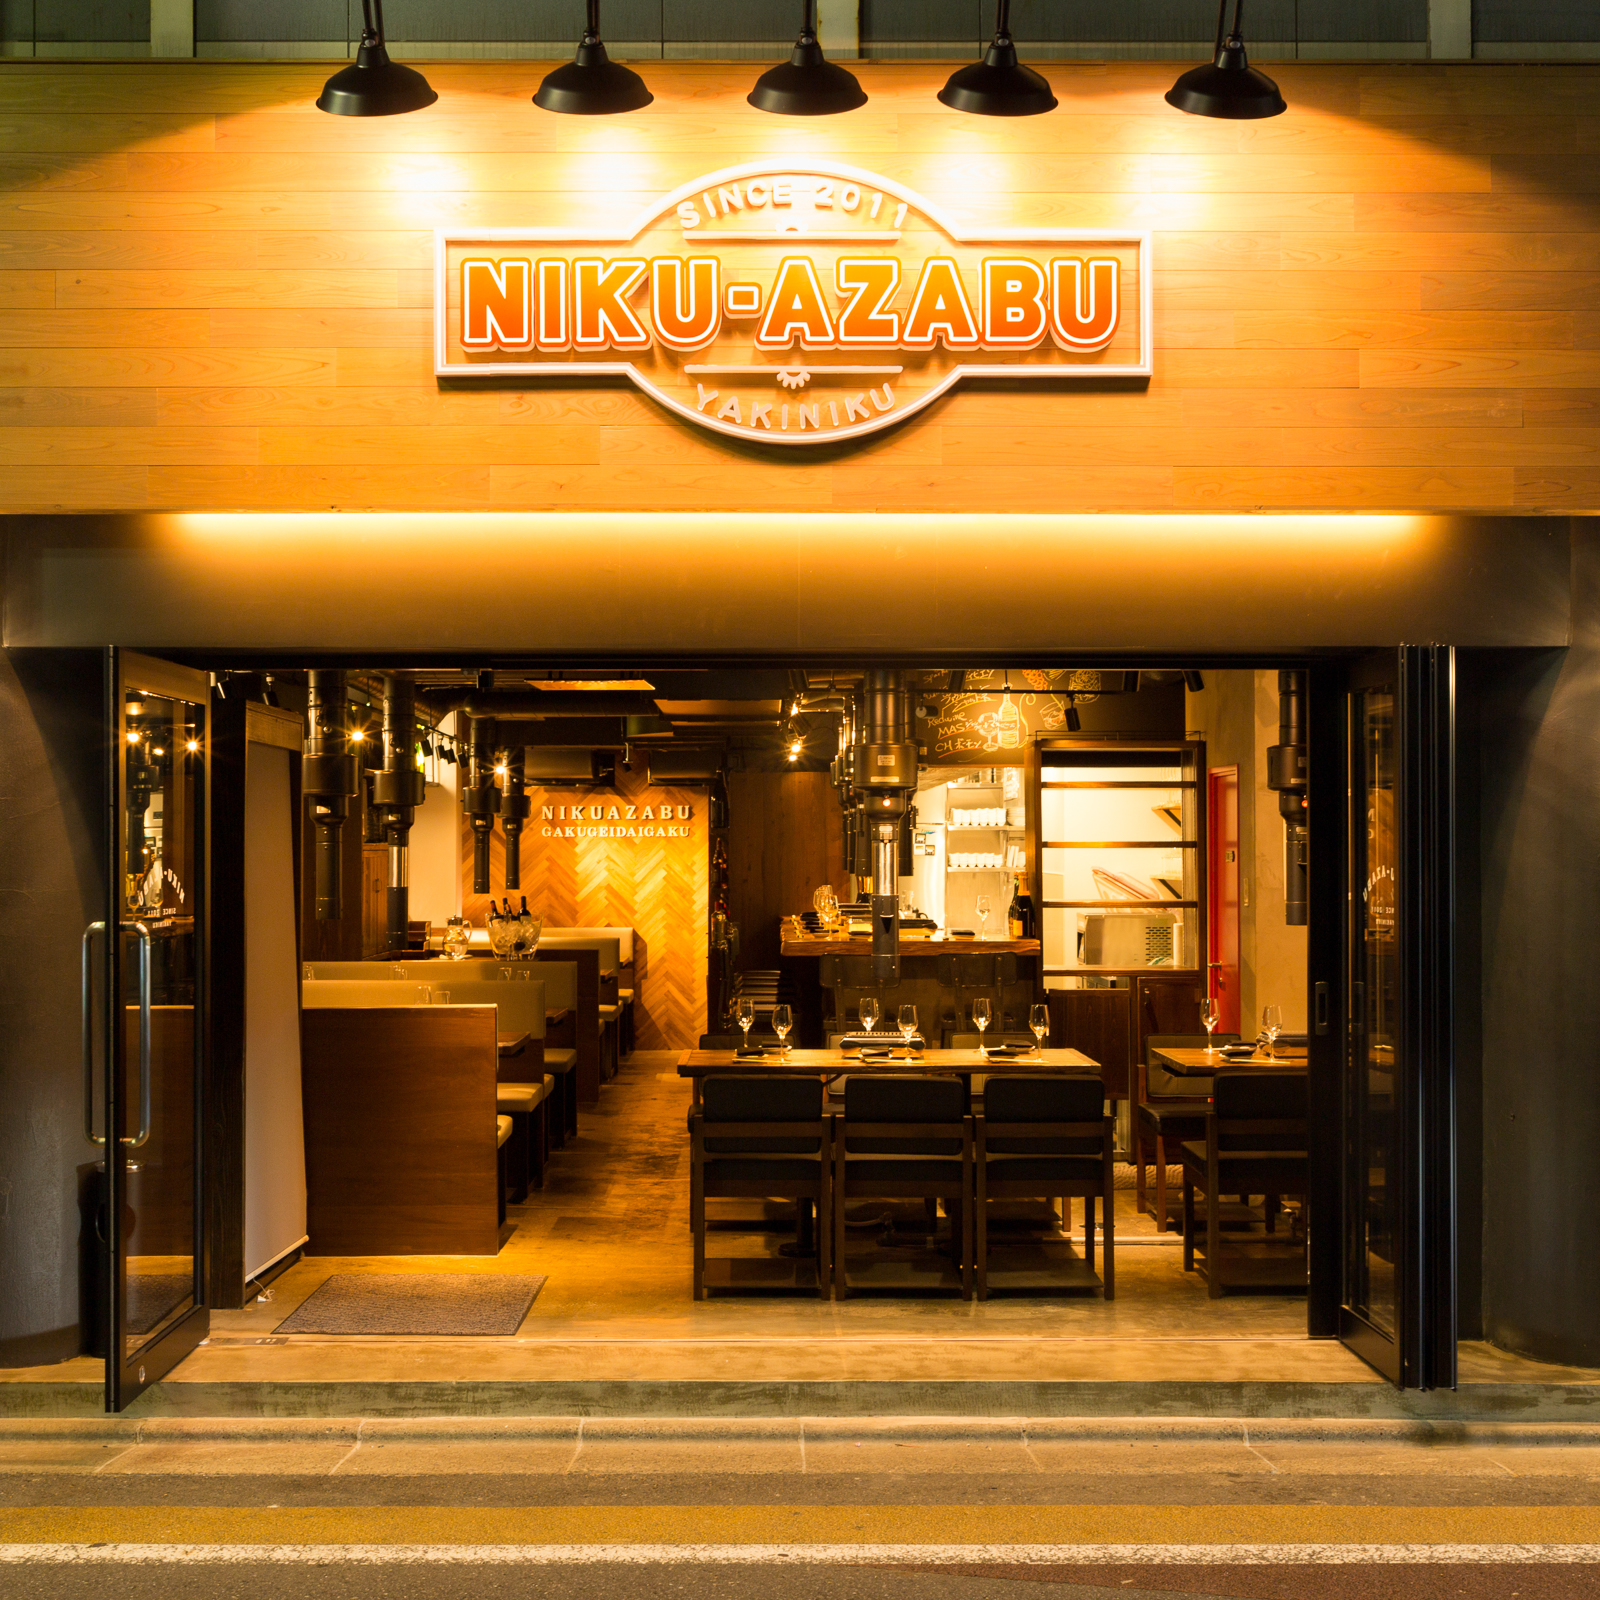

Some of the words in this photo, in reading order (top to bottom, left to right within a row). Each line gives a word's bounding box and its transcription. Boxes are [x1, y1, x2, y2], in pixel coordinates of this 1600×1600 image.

[677, 179, 794, 230] SINCE
[813, 179, 908, 230] 2011
[460, 255, 1123, 353] NIKU-AZABU
[696, 381, 897, 431] YAKINIKU
[541, 805, 691, 820] NIKUAZABU
[541, 826, 691, 838] GAKUGEIDAIGAKU
